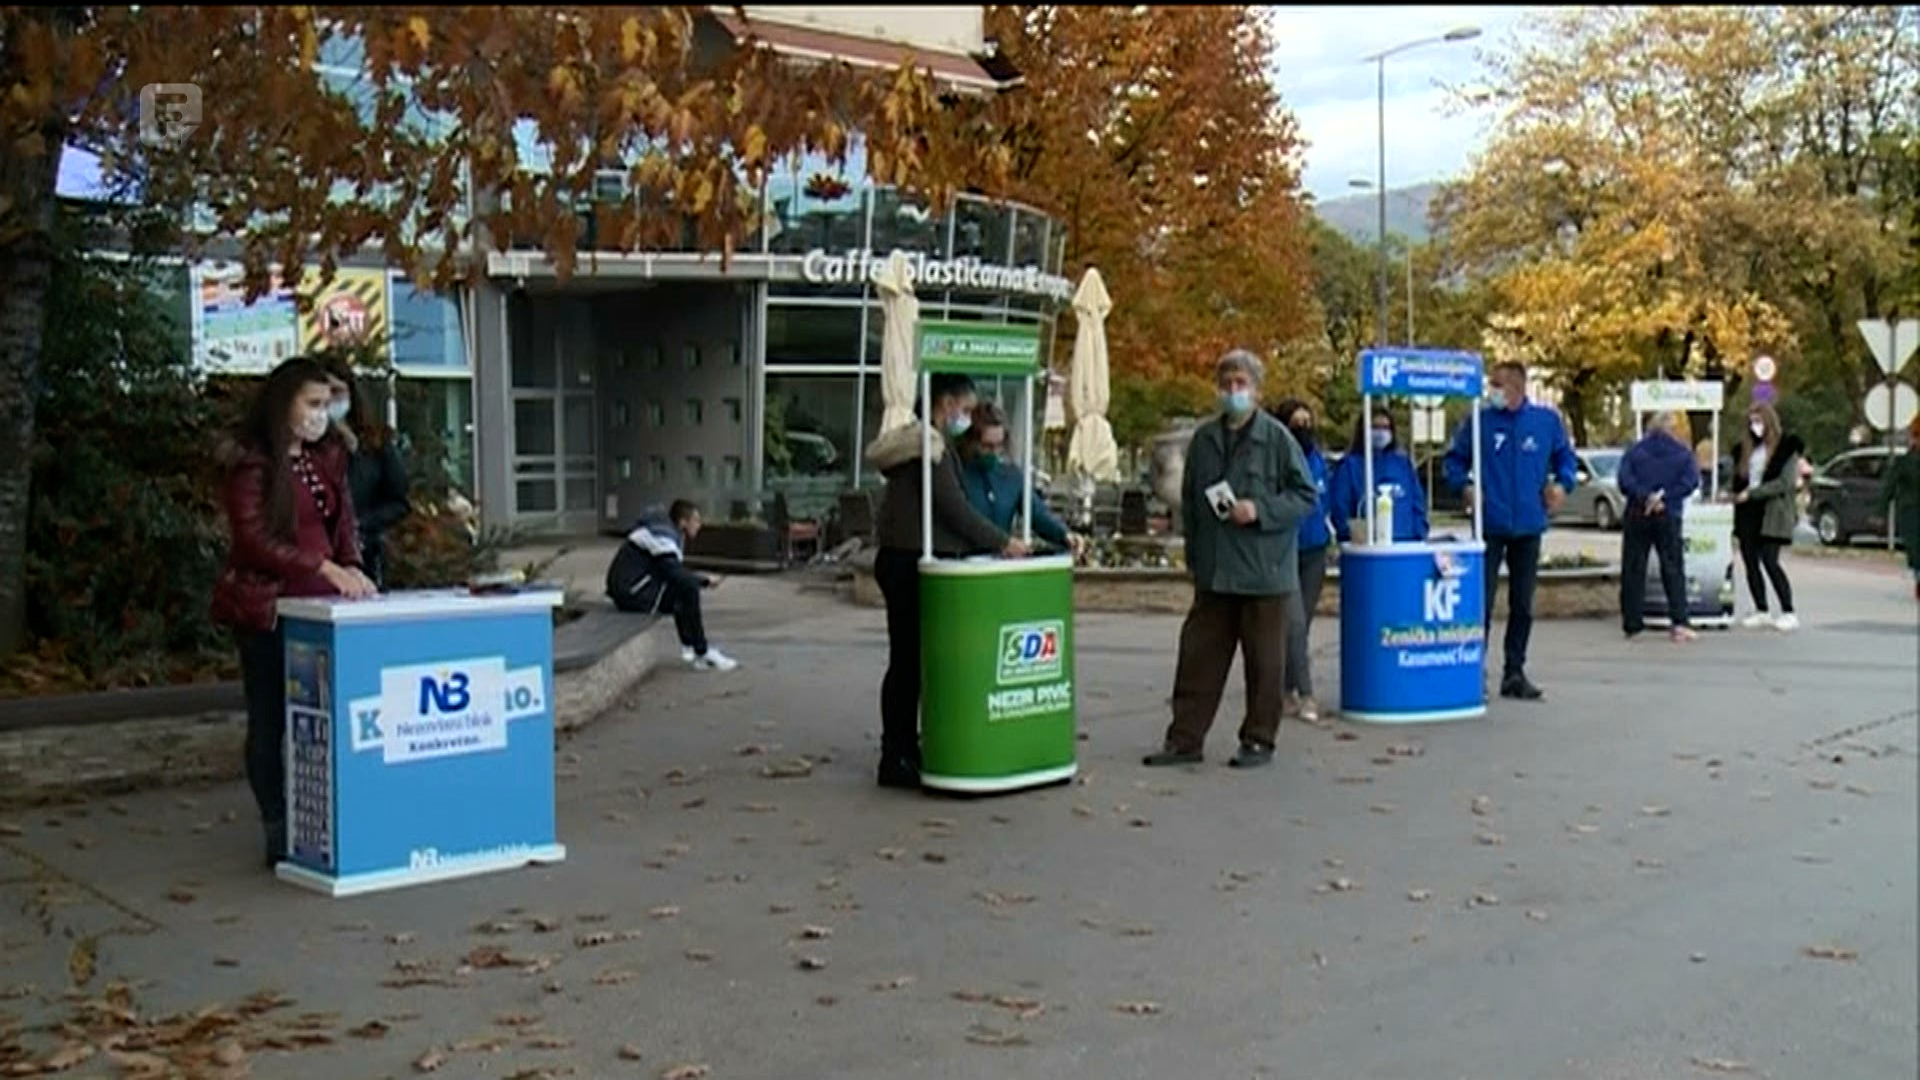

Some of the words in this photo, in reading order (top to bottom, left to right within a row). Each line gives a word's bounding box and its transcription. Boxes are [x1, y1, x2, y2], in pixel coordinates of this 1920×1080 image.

[803, 248, 886, 283] Caffe
[1373, 357, 1398, 387] KF
[1424, 579, 1461, 621] KF
[1003, 632, 1057, 665] SDA
